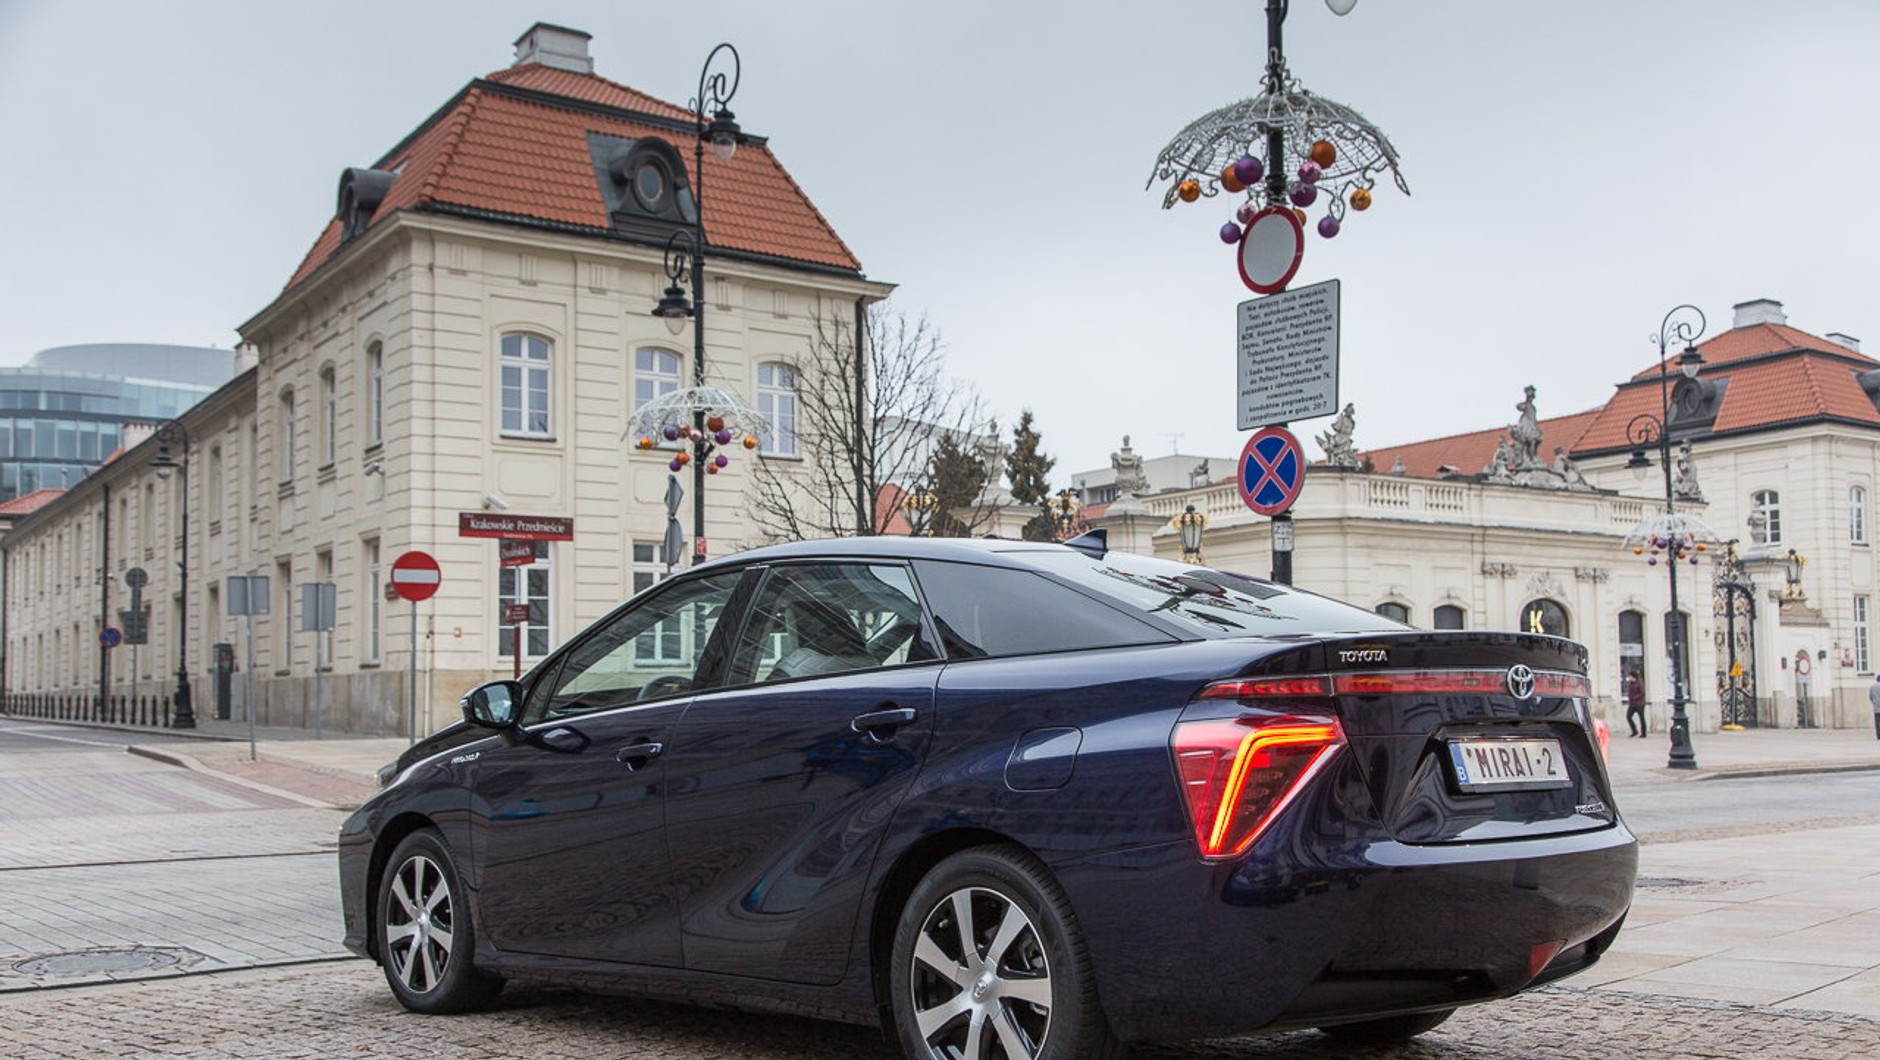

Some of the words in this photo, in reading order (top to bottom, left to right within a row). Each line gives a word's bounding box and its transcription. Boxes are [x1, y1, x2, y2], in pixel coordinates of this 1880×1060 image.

[470, 519, 515, 531] Krakowskie
[517, 520, 565, 533] Przedmieście
[1338, 650, 1388, 662] TOYOTA
[1457, 766, 1467, 781] B
